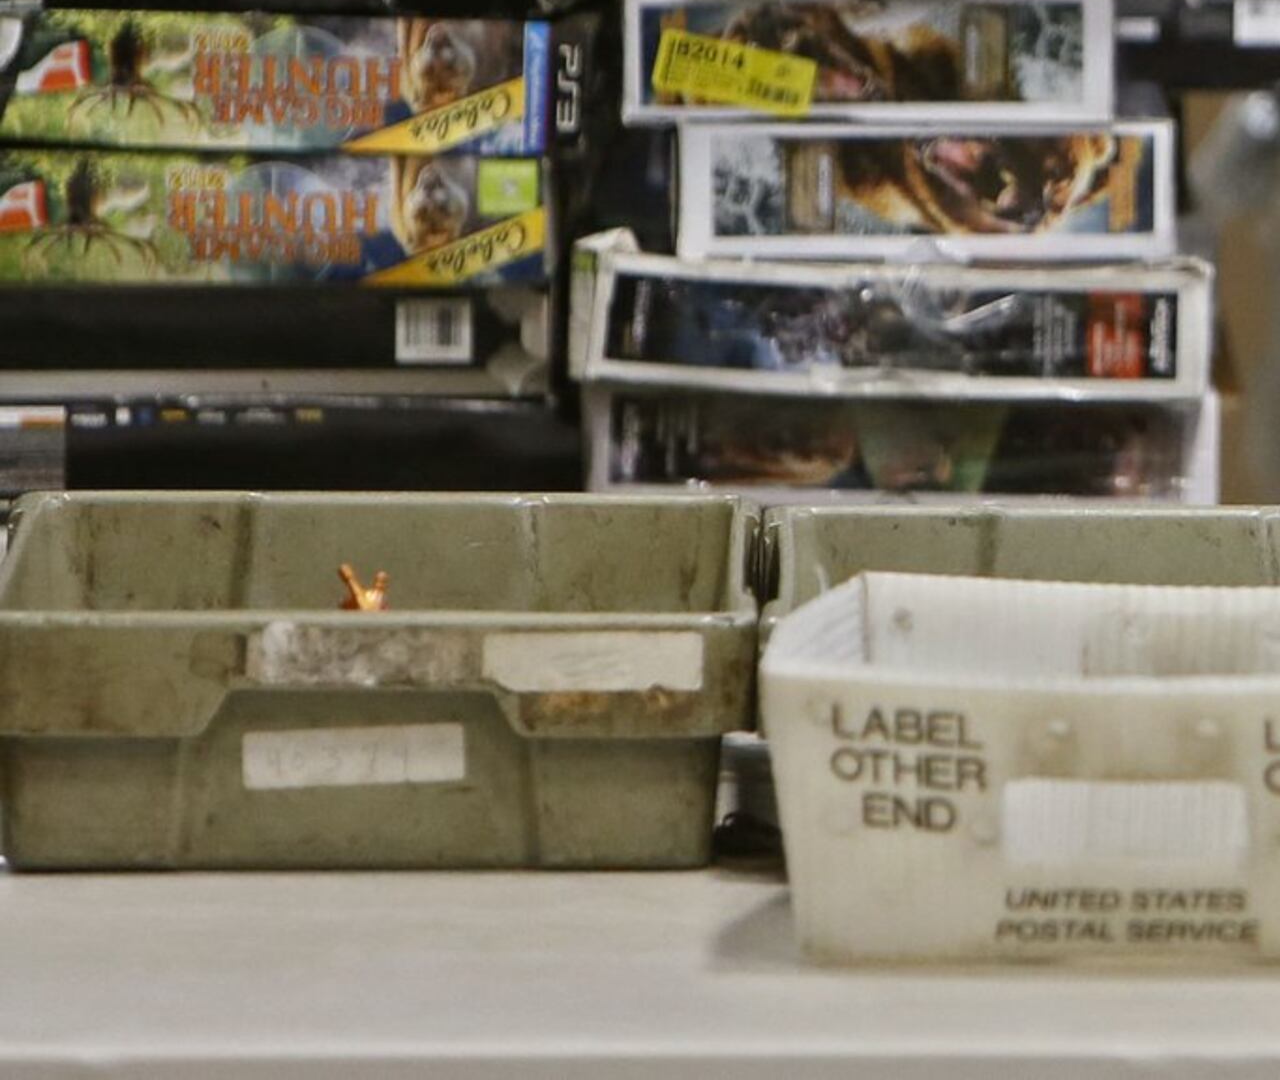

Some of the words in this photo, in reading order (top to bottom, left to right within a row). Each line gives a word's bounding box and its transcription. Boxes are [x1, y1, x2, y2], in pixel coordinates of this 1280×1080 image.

[192, 50, 400, 101] HUNTER
[556, 43, 583, 134] PS3
[169, 189, 379, 238] HUNTER
[831, 702, 984, 751] LABEL
[829, 748, 988, 792] OTHER
[861, 793, 957, 834] END
[1004, 888, 1121, 914] UNITED
[1128, 888, 1249, 914] STATES
[994, 919, 1116, 944] POSTAL
[1124, 919, 1263, 944] SERVICE
